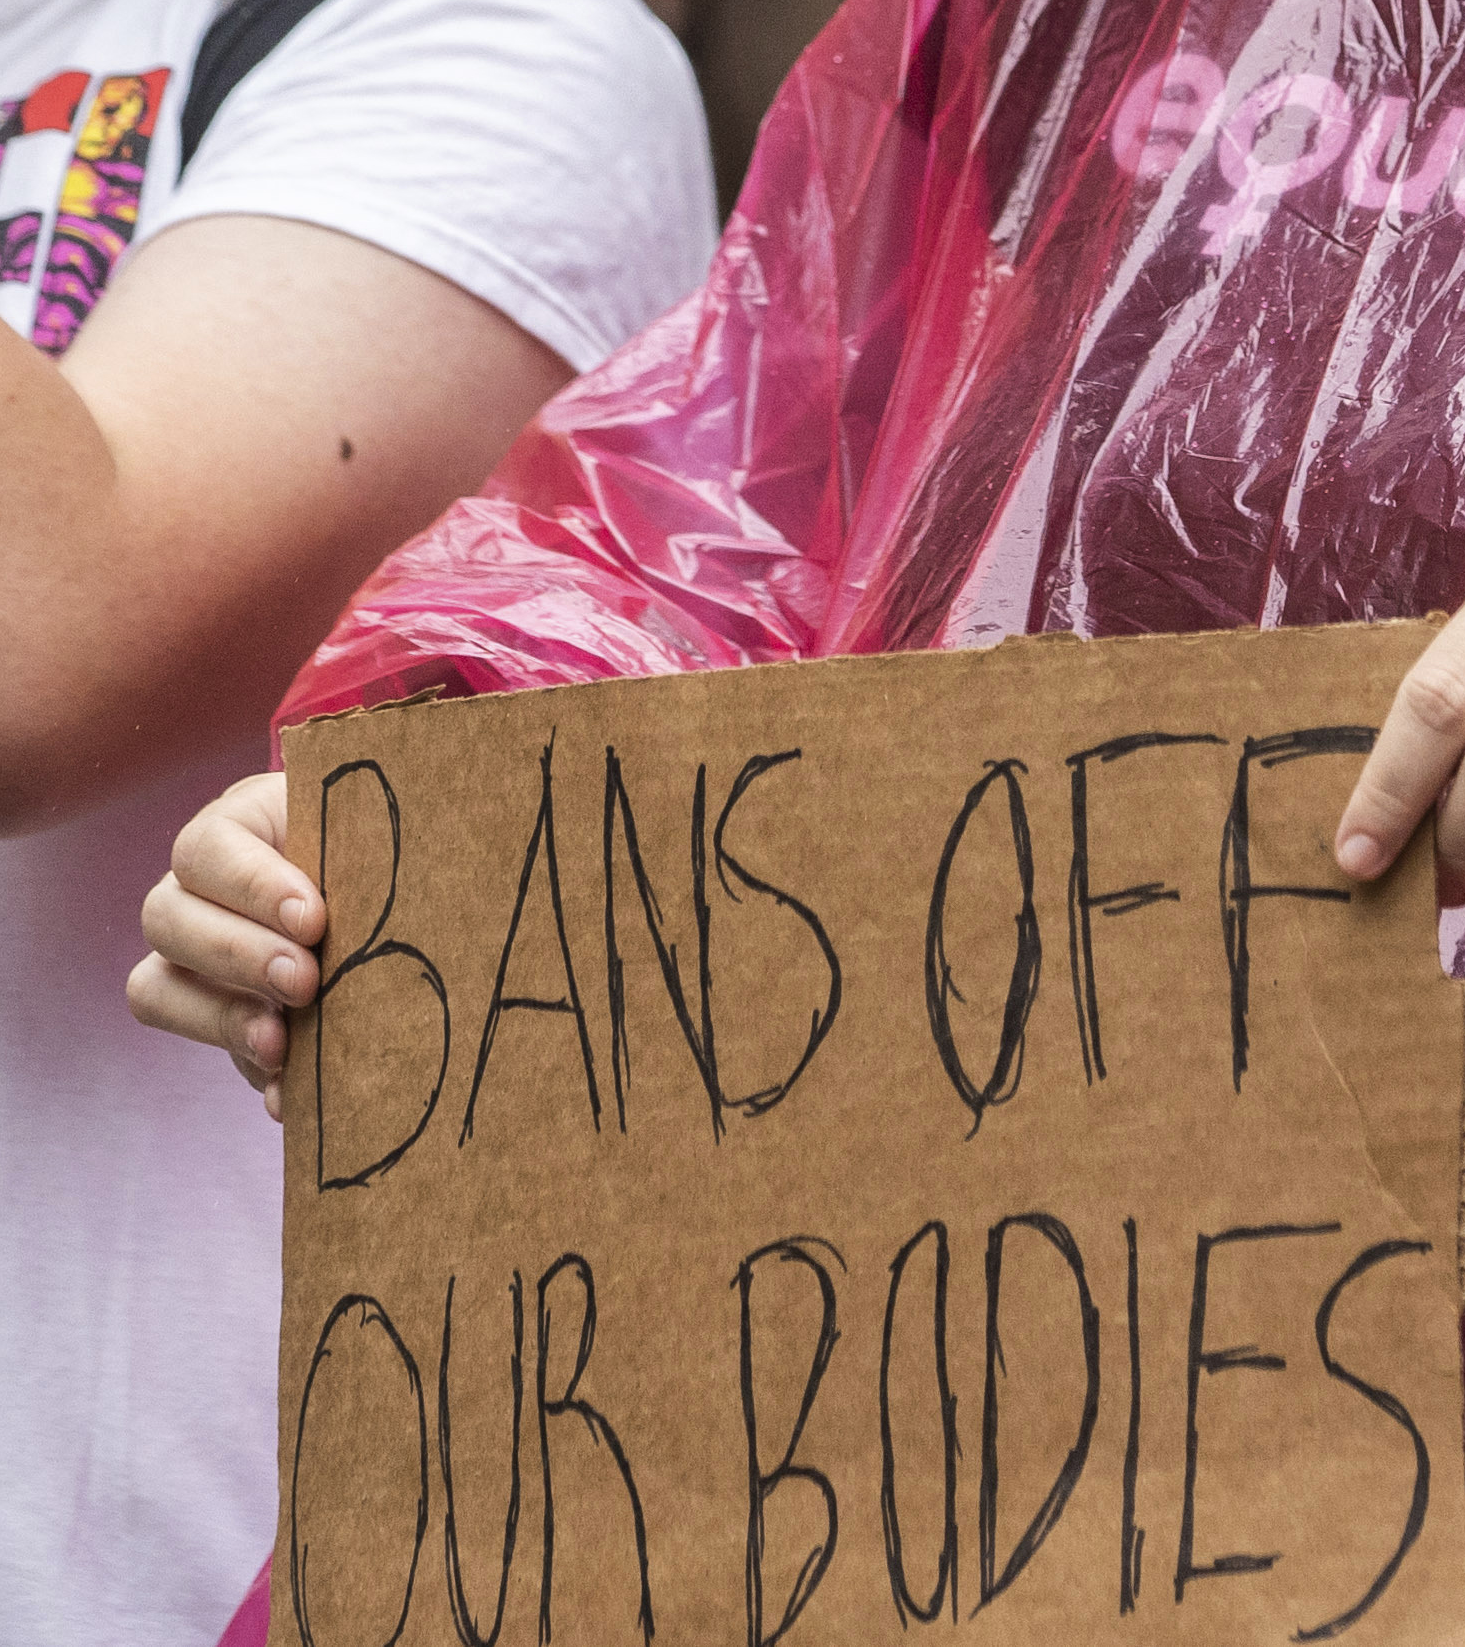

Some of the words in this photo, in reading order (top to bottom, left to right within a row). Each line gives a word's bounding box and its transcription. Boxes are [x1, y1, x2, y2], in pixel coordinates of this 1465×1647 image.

[315, 724, 842, 1194] BANS
[924, 724, 1382, 1142] OFF
[290, 1252, 654, 1647] OUR
[730, 1211, 1433, 1647] BODIES
